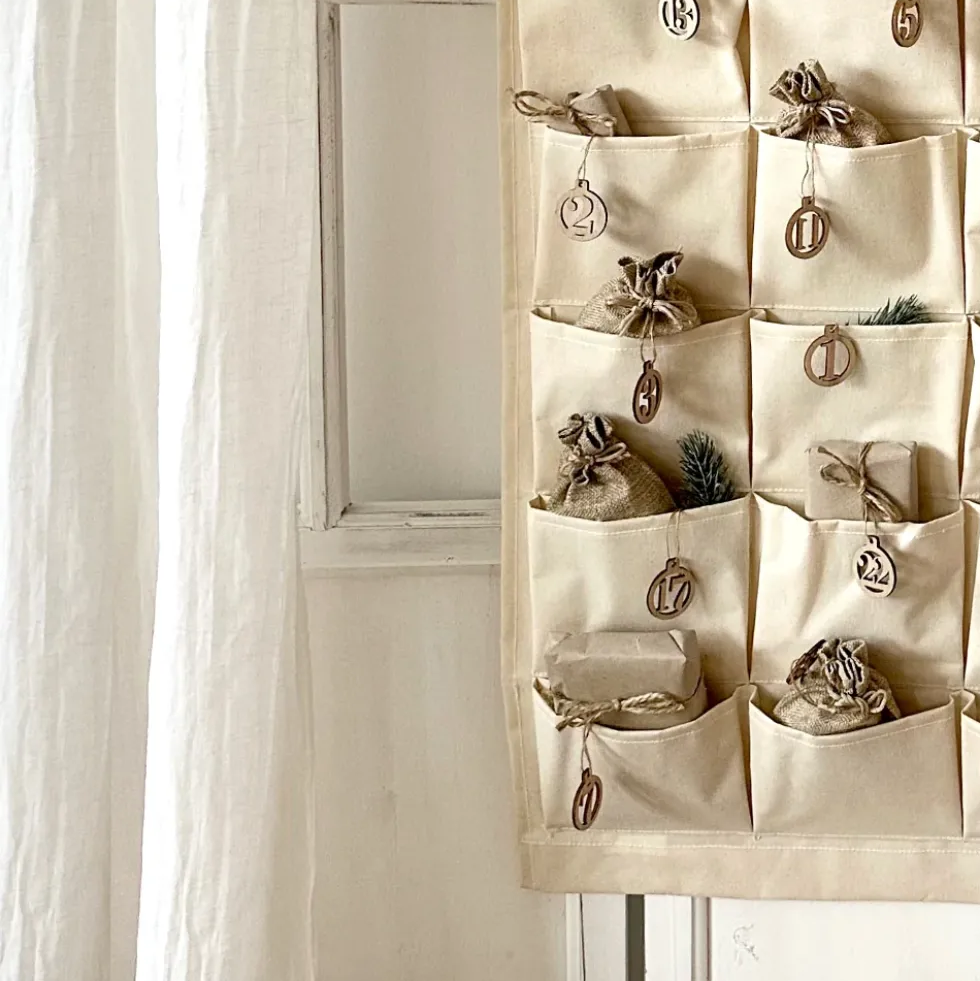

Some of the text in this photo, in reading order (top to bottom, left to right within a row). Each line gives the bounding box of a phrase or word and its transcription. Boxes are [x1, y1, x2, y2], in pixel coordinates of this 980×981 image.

[795, 212, 821, 250] 11
[819, 339, 842, 380] 1
[858, 551, 891, 589] 22
[657, 575, 690, 612] 17
